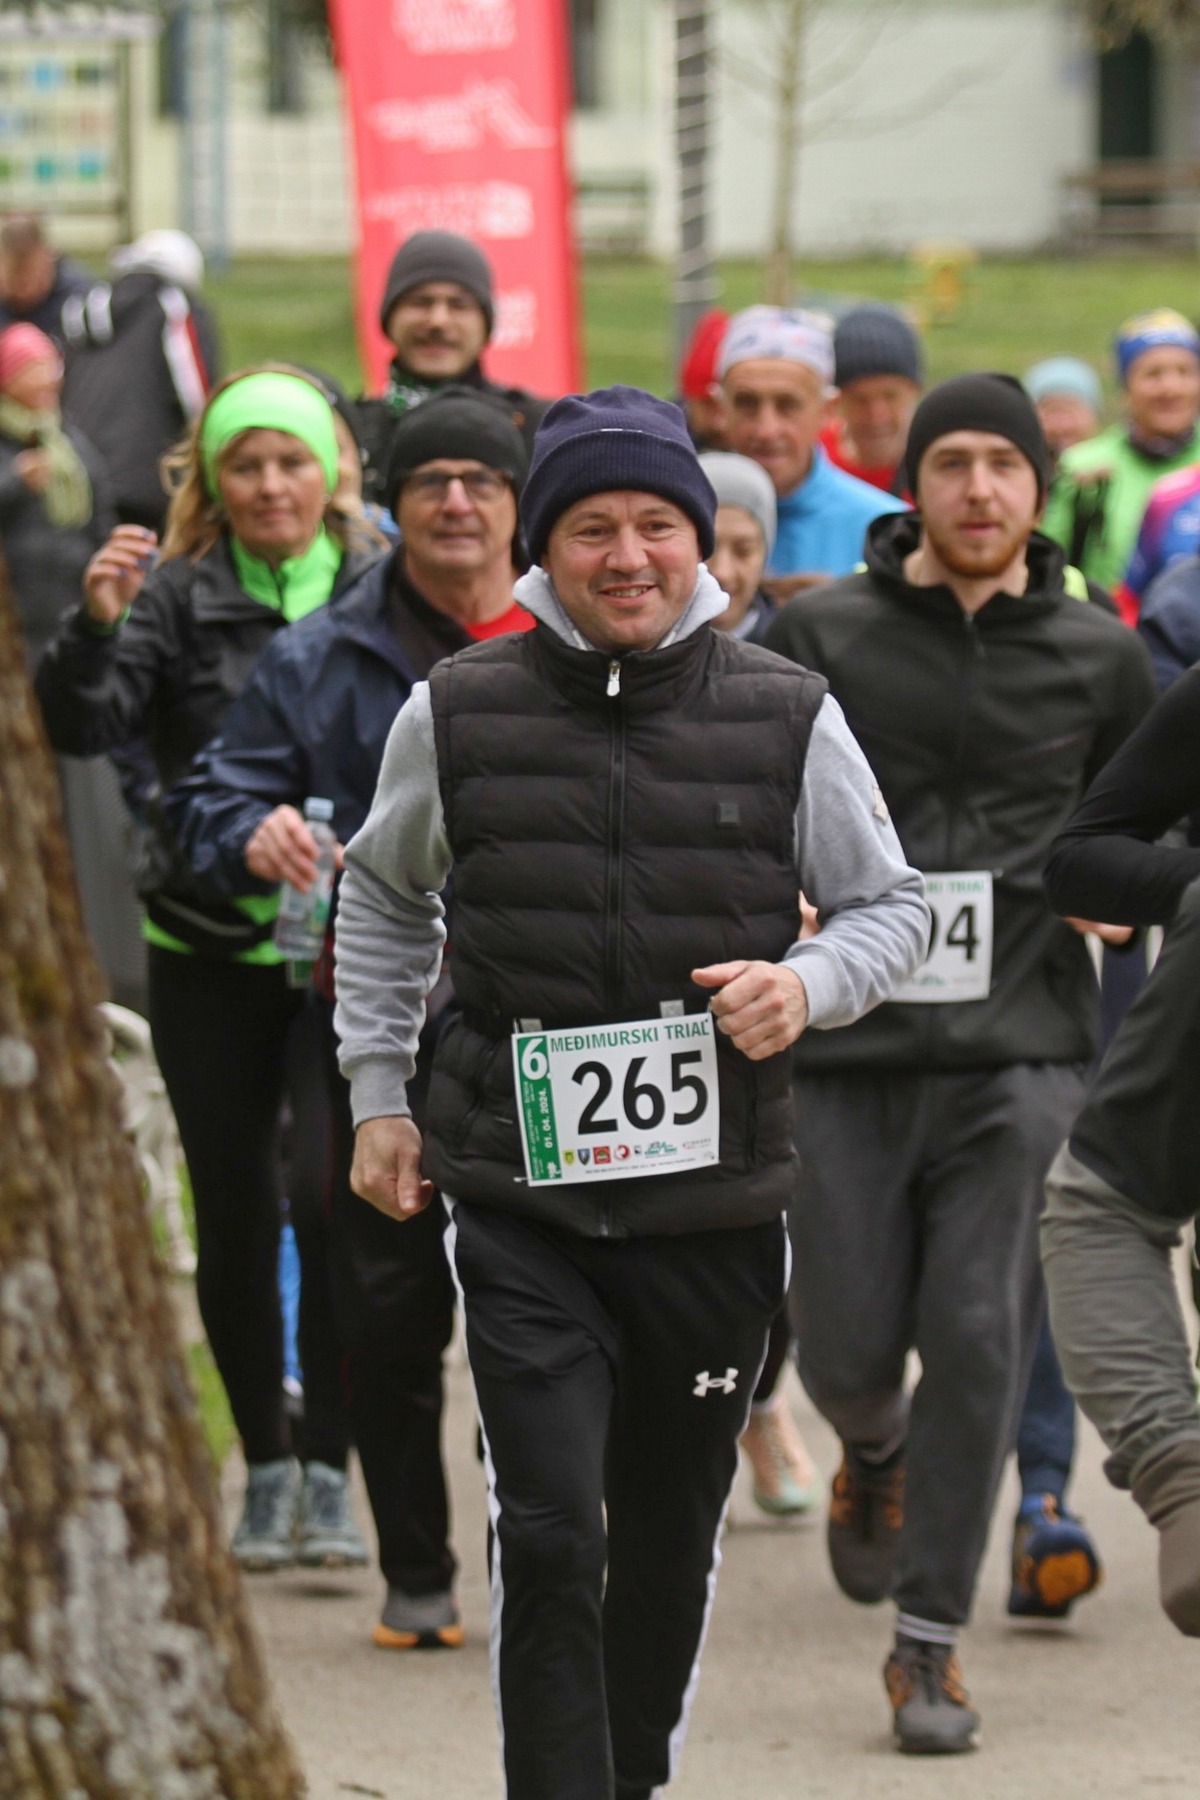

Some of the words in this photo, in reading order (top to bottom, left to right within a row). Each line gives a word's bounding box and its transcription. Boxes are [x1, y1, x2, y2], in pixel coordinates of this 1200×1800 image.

[551, 1027, 659, 1053] MEĐIMURSKI
[664, 1020, 710, 1041] TRIAL
[571, 1049, 709, 1136] 265
